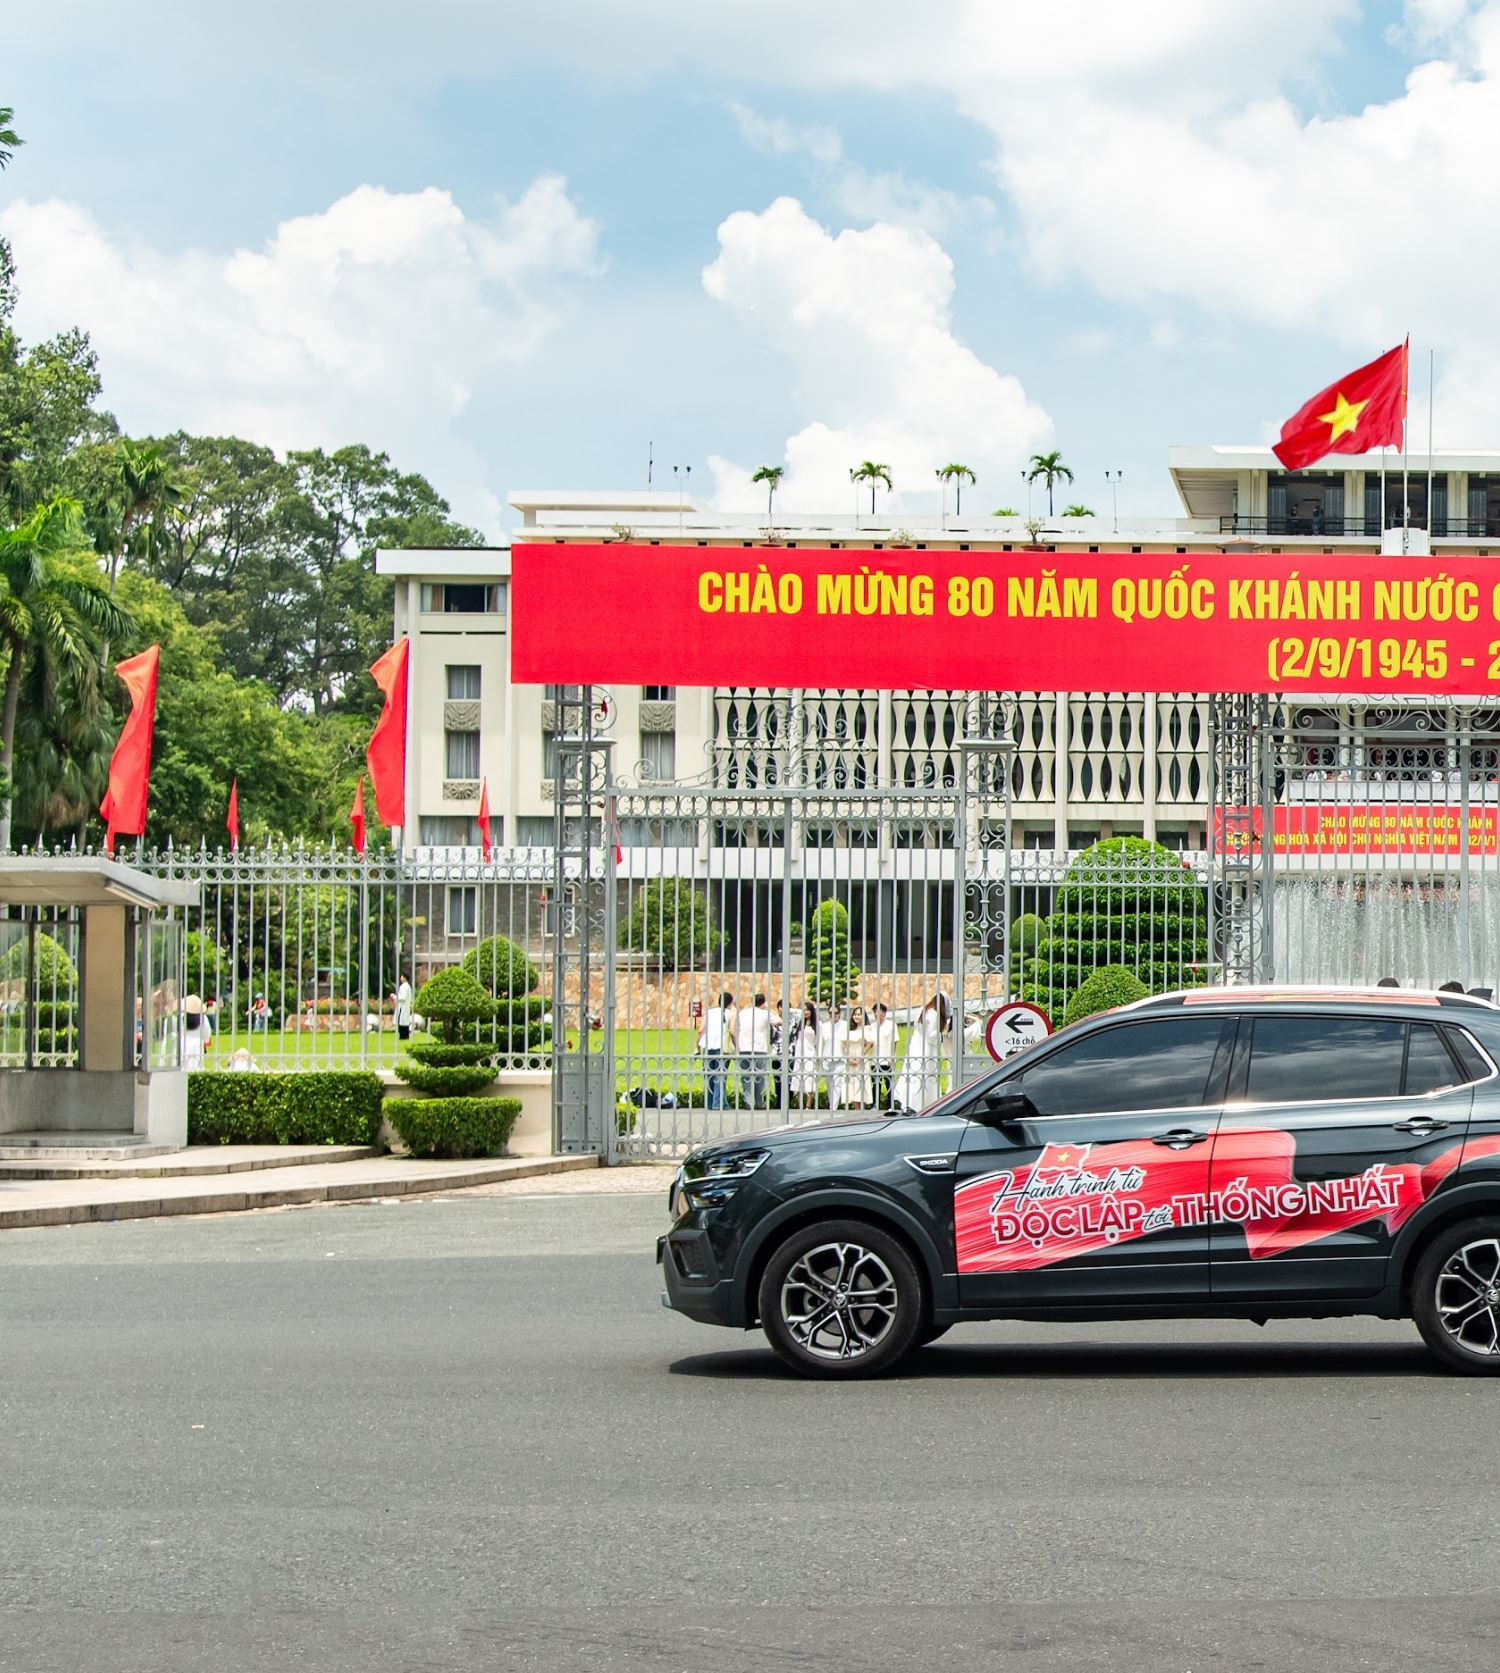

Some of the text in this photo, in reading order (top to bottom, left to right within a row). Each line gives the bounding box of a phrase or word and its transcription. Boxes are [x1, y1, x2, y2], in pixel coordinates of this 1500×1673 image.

[698, 564, 803, 615] CHÀO
[816, 566, 934, 616] MỪNG
[947, 575, 994, 618] 80
[1007, 569, 1098, 619] NĂM
[1111, 565, 1215, 624] QUỐC
[1228, 571, 1361, 621] KHÁNH
[1373, 573, 1479, 622] NƯỚC
[1267, 637, 1448, 682] (2/9/1945
[1460, 657, 1475, 667] -
[1457, 816, 1493, 829] KÁNH
[994, 1201, 1076, 1247] ĐỘC
[1081, 1194, 1145, 1240] LẬP
[1173, 1177, 1304, 1226] THỐNG
[1309, 1164, 1404, 1214] NHẤT
